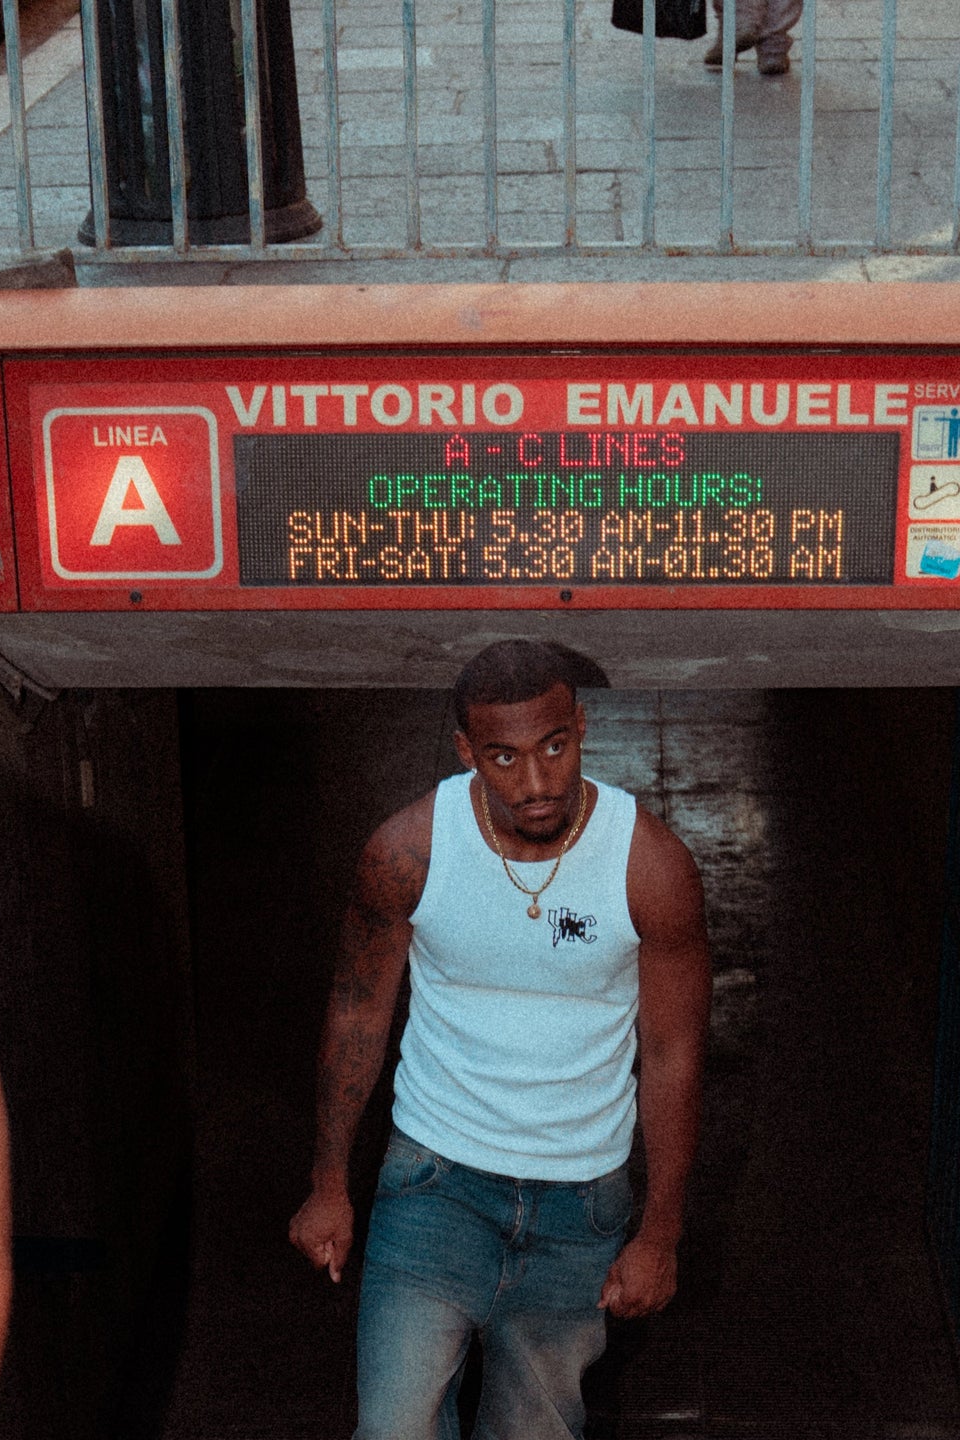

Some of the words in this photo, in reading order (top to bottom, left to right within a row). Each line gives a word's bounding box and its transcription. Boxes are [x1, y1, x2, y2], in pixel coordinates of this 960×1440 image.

[225, 383, 524, 427] VITTORIO
[566, 383, 909, 426] EMANUELE
[93, 426, 168, 446] LINEA
[444, 433, 469, 466] A
[518, 433, 542, 466] C
[559, 433, 685, 467] LINES
[90, 455, 182, 546] A
[369, 474, 602, 508] OPERATING
[620, 473, 762, 507] HOURS:
[491, 511, 584, 543] 5.30
[791, 510, 843, 542] PM
[483, 546, 575, 579] 5.30
[790, 545, 842, 579] AM
